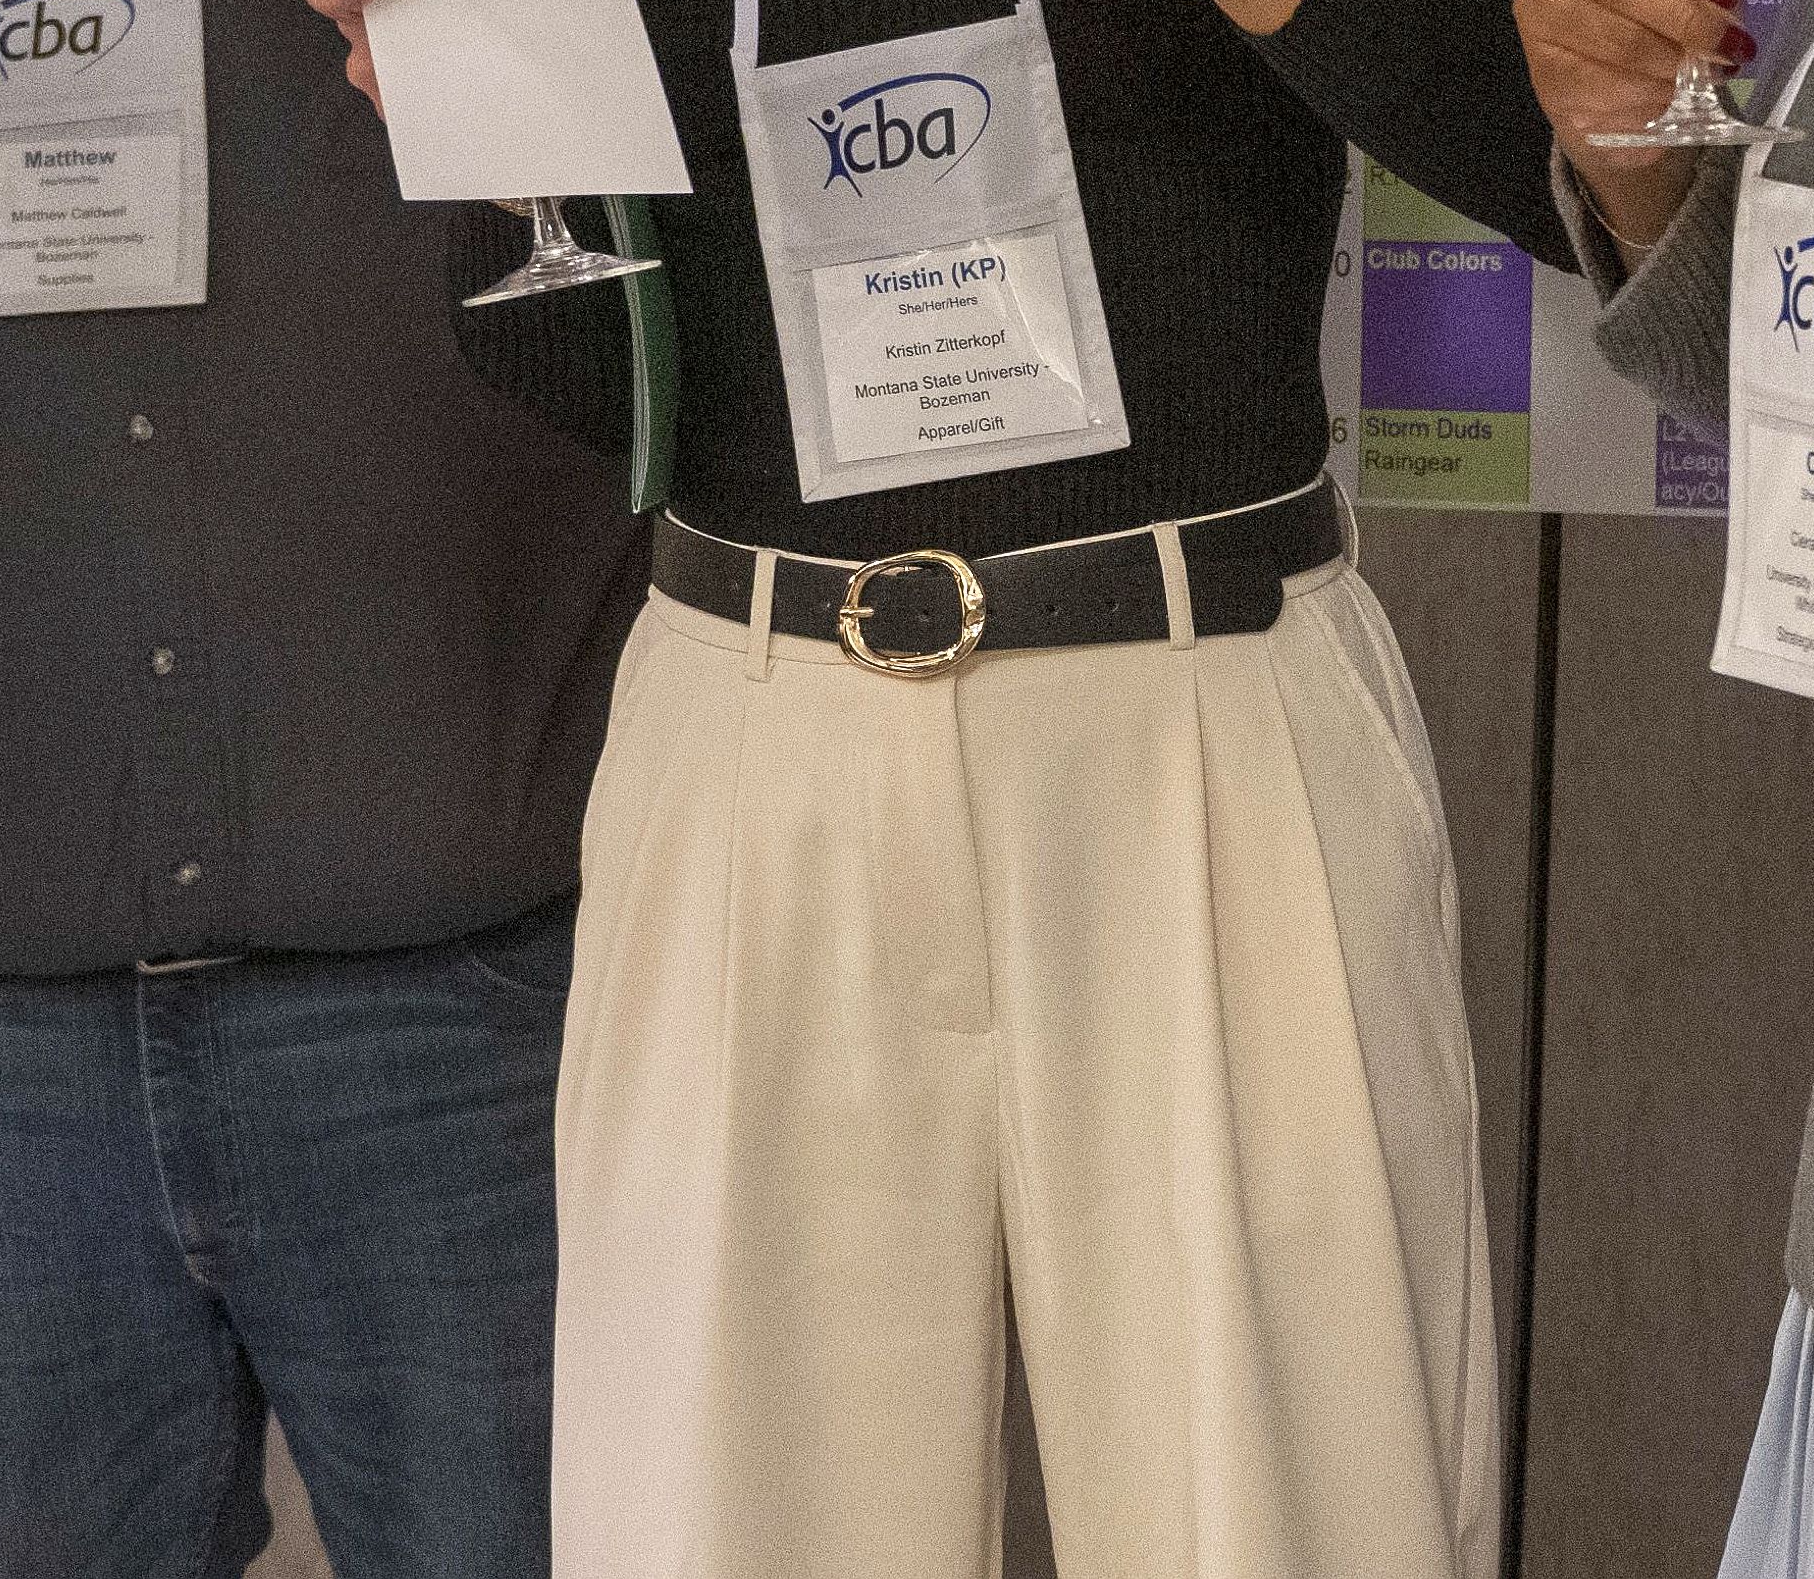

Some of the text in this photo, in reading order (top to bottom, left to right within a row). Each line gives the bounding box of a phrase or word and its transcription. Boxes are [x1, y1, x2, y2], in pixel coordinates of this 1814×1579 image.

[24, 150, 117, 169] Matthew
[807, 97, 957, 197] icba
[11, 210, 66, 223] Matthew
[1367, 248, 1420, 271] Club
[1428, 249, 1503, 272] Colors
[864, 255, 1007, 296] Kristin (KP)
[897, 294, 979, 316] She/Her/Hers
[885, 329, 1006, 360] Kristin Zitterkopf
[854, 379, 919, 400] Montana
[922, 372, 962, 392] State
[965, 361, 1040, 387] University
[919, 388, 991, 411] Bozeman
[917, 415, 1005, 442] Apparel/Gift
[1365, 417, 1429, 439] Storm
[1438, 417, 1493, 440] Duds
[1364, 450, 1462, 477] Raingear
